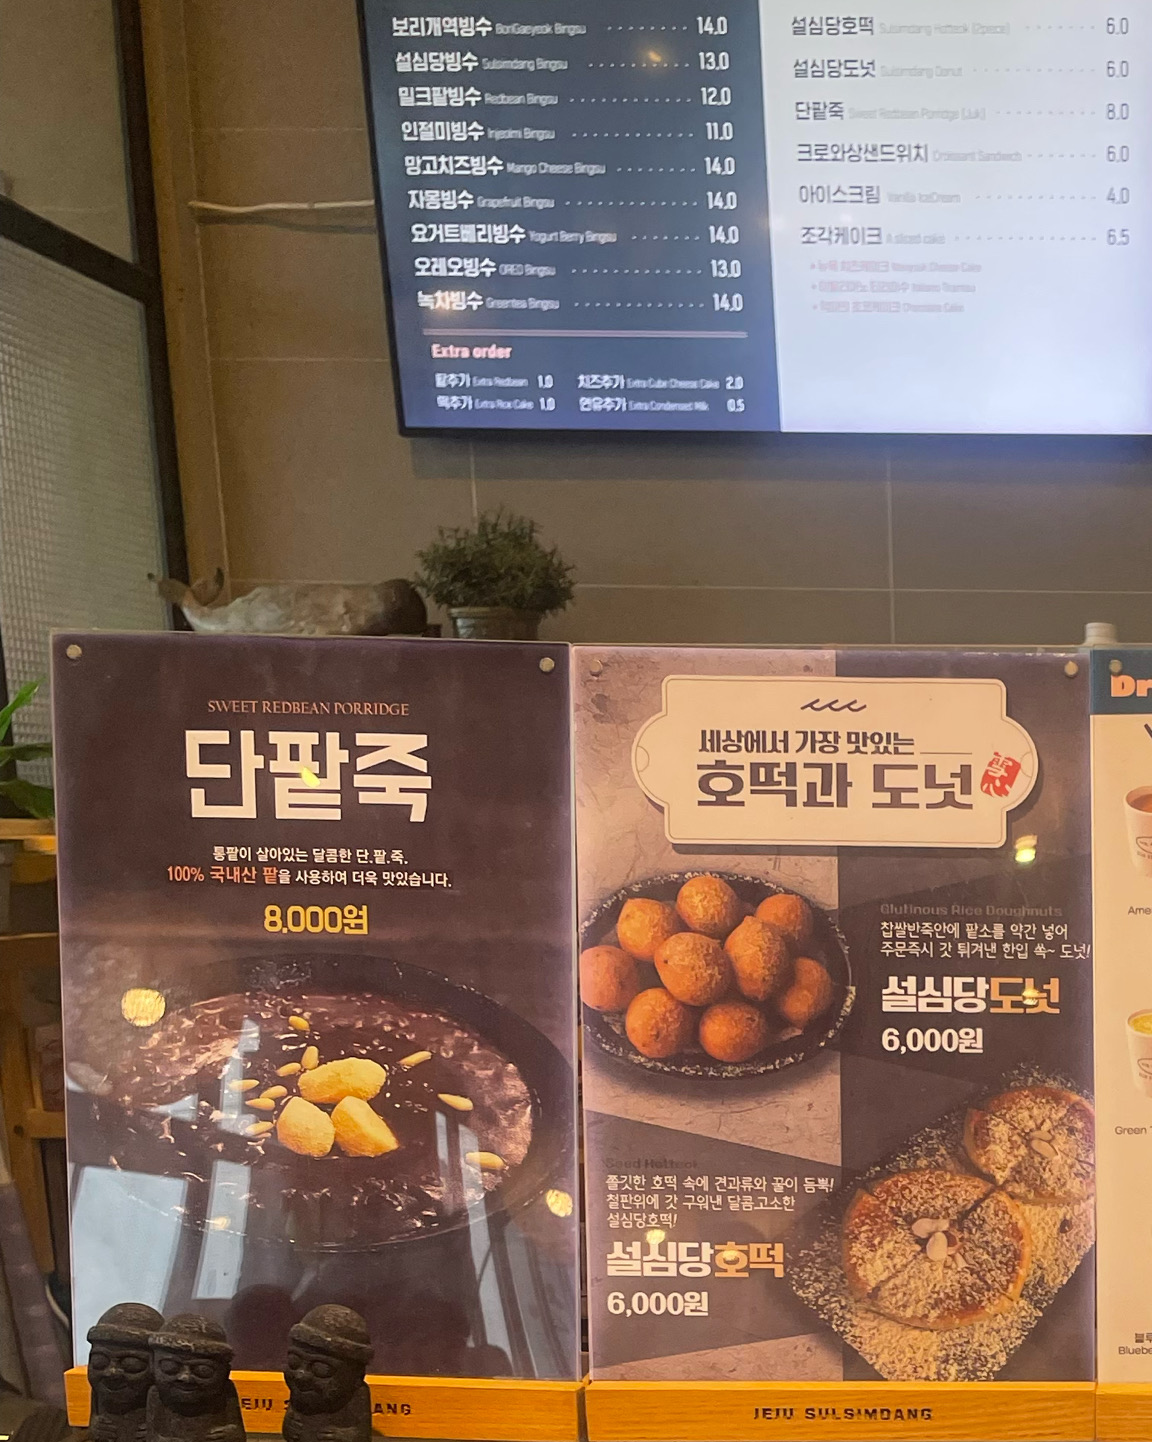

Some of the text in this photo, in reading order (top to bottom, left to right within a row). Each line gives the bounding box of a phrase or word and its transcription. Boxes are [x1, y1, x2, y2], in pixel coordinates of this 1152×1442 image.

[392, 17, 492, 37] 보리개역빙수
[697, 17, 728, 35] 14.0
[791, 16, 874, 36] 설심당호떡
[1106, 17, 1129, 35] 6.0
[396, 52, 478, 72] 설심당빙수
[699, 52, 730, 70] 13.0
[793, 58, 876, 79] 설심당도넛
[795, 101, 844, 120] 단팥죽
[1106, 103, 1130, 120] 8.0
[401, 121, 733, 142] 인절미빙수 11.0
[797, 143, 928, 163] 크로와상샌드위치
[405, 155, 503, 176] 망고치즈빙수
[407, 190, 473, 210] 자몽빙수
[799, 185, 880, 204] 아이스크림
[411, 223, 526, 245] 요거트베리빙수
[801, 226, 882, 245] 조각케이크
[431, 344, 512, 359] Extra order
[208, 700, 409, 716] SWEET REDBEAN PORRIDGE
[699, 729, 915, 756] 세상에서 가장 맛있는
[185, 729, 432, 823] 단팥죽
[697, 759, 974, 810] 호떡과 도넛
[212, 846, 408, 866] 통팥이 살아있는 달콤한 단.팥.죽.
[168, 866, 452, 888] 100% 국내산 팥을 사용하여 더욱 맛있습니다.
[880, 922, 1068, 940] 찹쌀반죽안에 팥소를 약간 넣어
[882, 976, 1060, 1014] 설심당도넛
[882, 1028, 983, 1054] 6,000원
[1115, 1126, 1147, 1135] Green
[606, 1241, 785, 1278] 설심당호떡
[607, 1291, 709, 1317] 6,000원
[753, 1407, 934, 1422] JEJU SULSIMDANG
